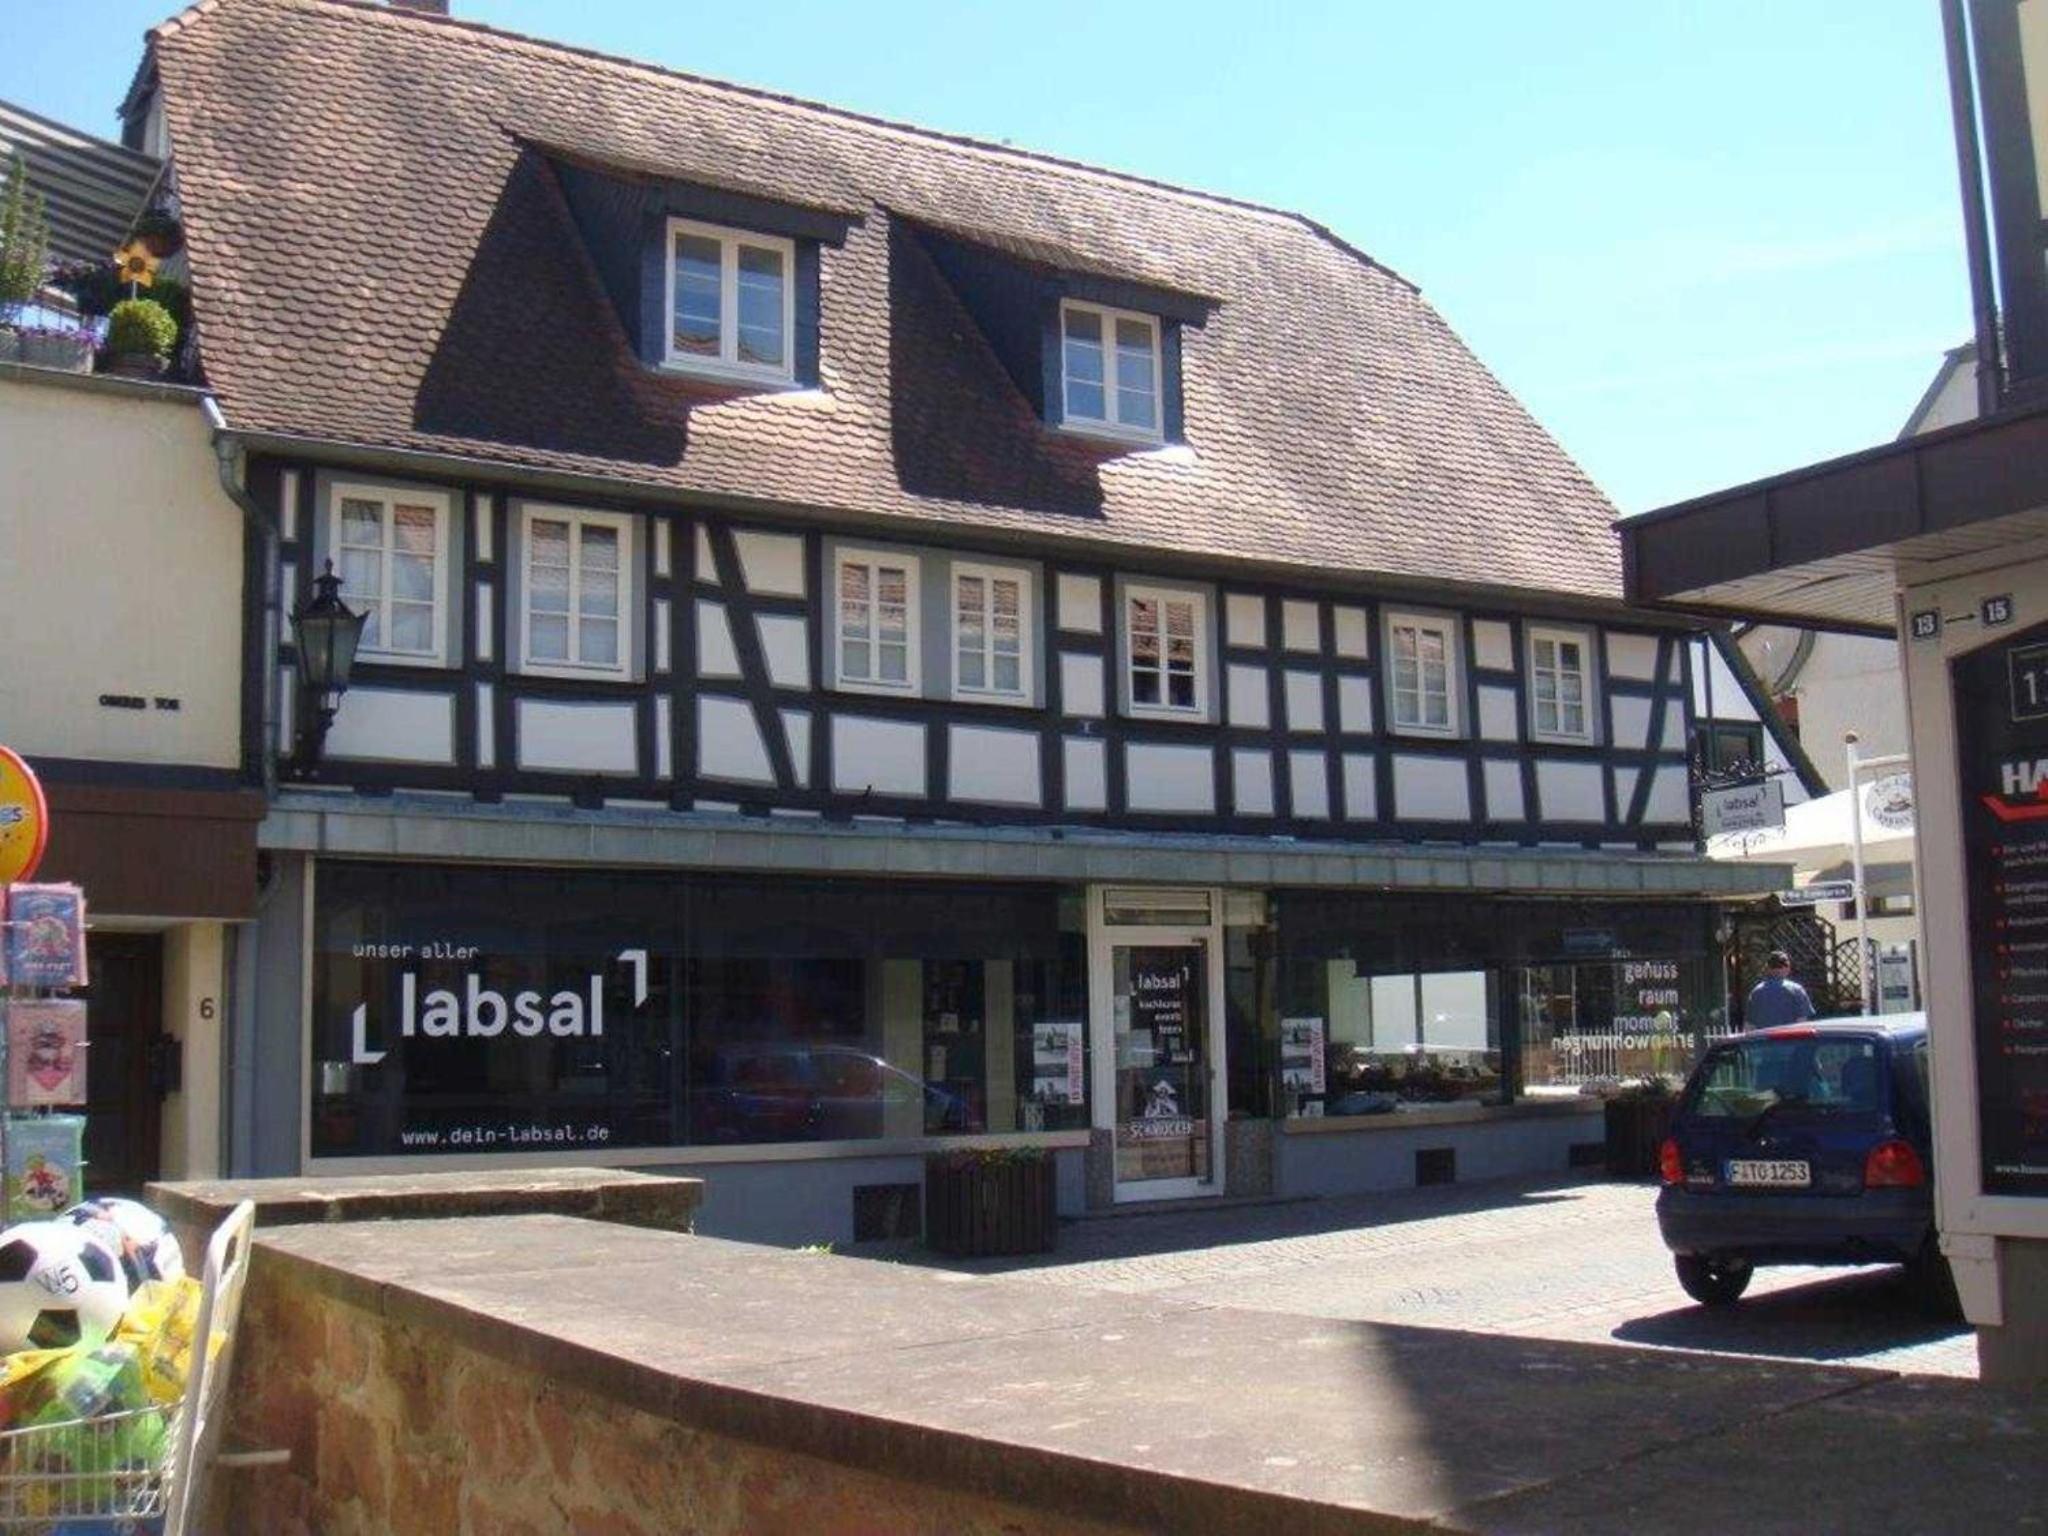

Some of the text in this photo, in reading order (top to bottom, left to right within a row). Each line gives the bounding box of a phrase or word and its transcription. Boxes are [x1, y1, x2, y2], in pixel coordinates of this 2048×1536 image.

[1987, 601, 2007, 622] 15
[1916, 614, 1935, 635] 13
[2023, 670, 2048, 704] 1
[353, 943, 479, 959] unser aller
[1138, 972, 1181, 990] labsal
[1624, 961, 1679, 983] genuss
[402, 972, 603, 1037] labsal
[1639, 987, 1679, 1005] raum
[200, 997, 215, 1020] 6
[402, 1125, 609, 1145] www.dein-labsal.de
